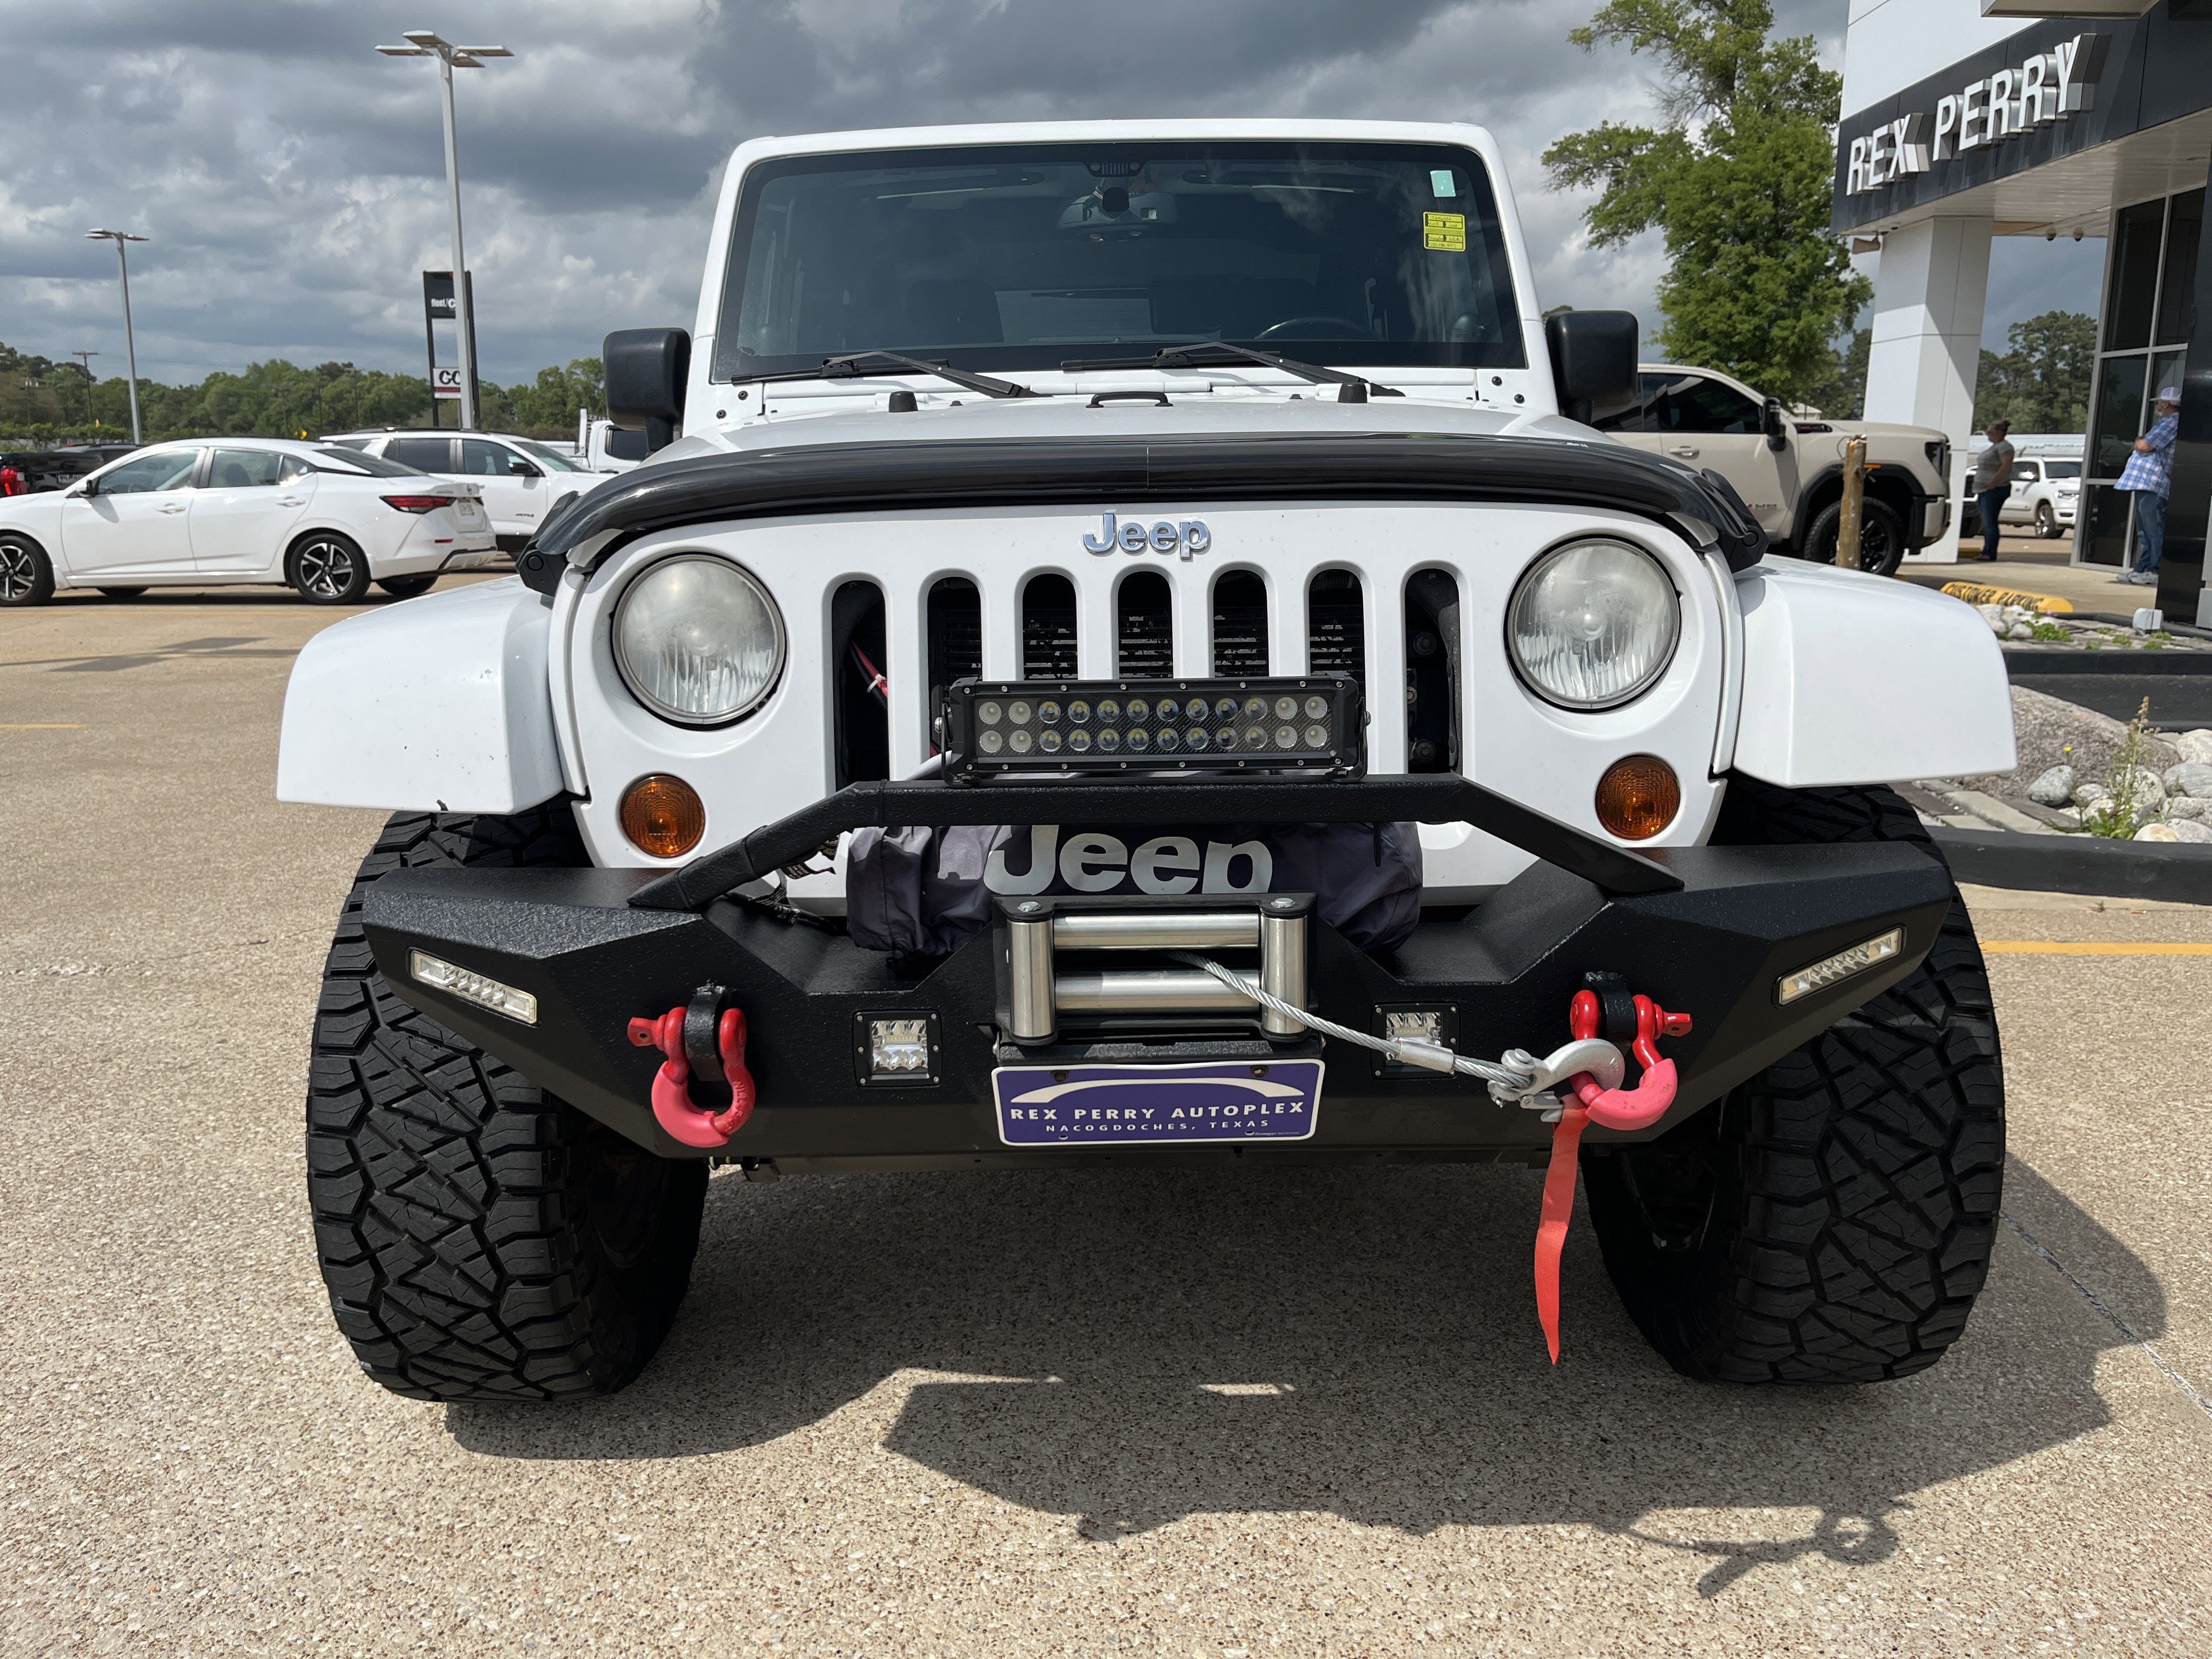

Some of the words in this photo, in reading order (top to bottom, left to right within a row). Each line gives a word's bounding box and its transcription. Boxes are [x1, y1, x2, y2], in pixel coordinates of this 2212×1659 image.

[1846, 112, 1927, 196] REX
[1932, 33, 2096, 162] PERRY
[1083, 513, 1209, 560] Jeep
[983, 825, 1273, 895] Jeep
[1011, 1108, 1058, 1120] REX
[1074, 1108, 1155, 1120] PERRY
[1171, 1102, 1304, 1119] AUTOPLEX
[1046, 1122, 1195, 1132] NACOGDOCHES,
[1209, 1120, 1268, 1128] TEXAS
